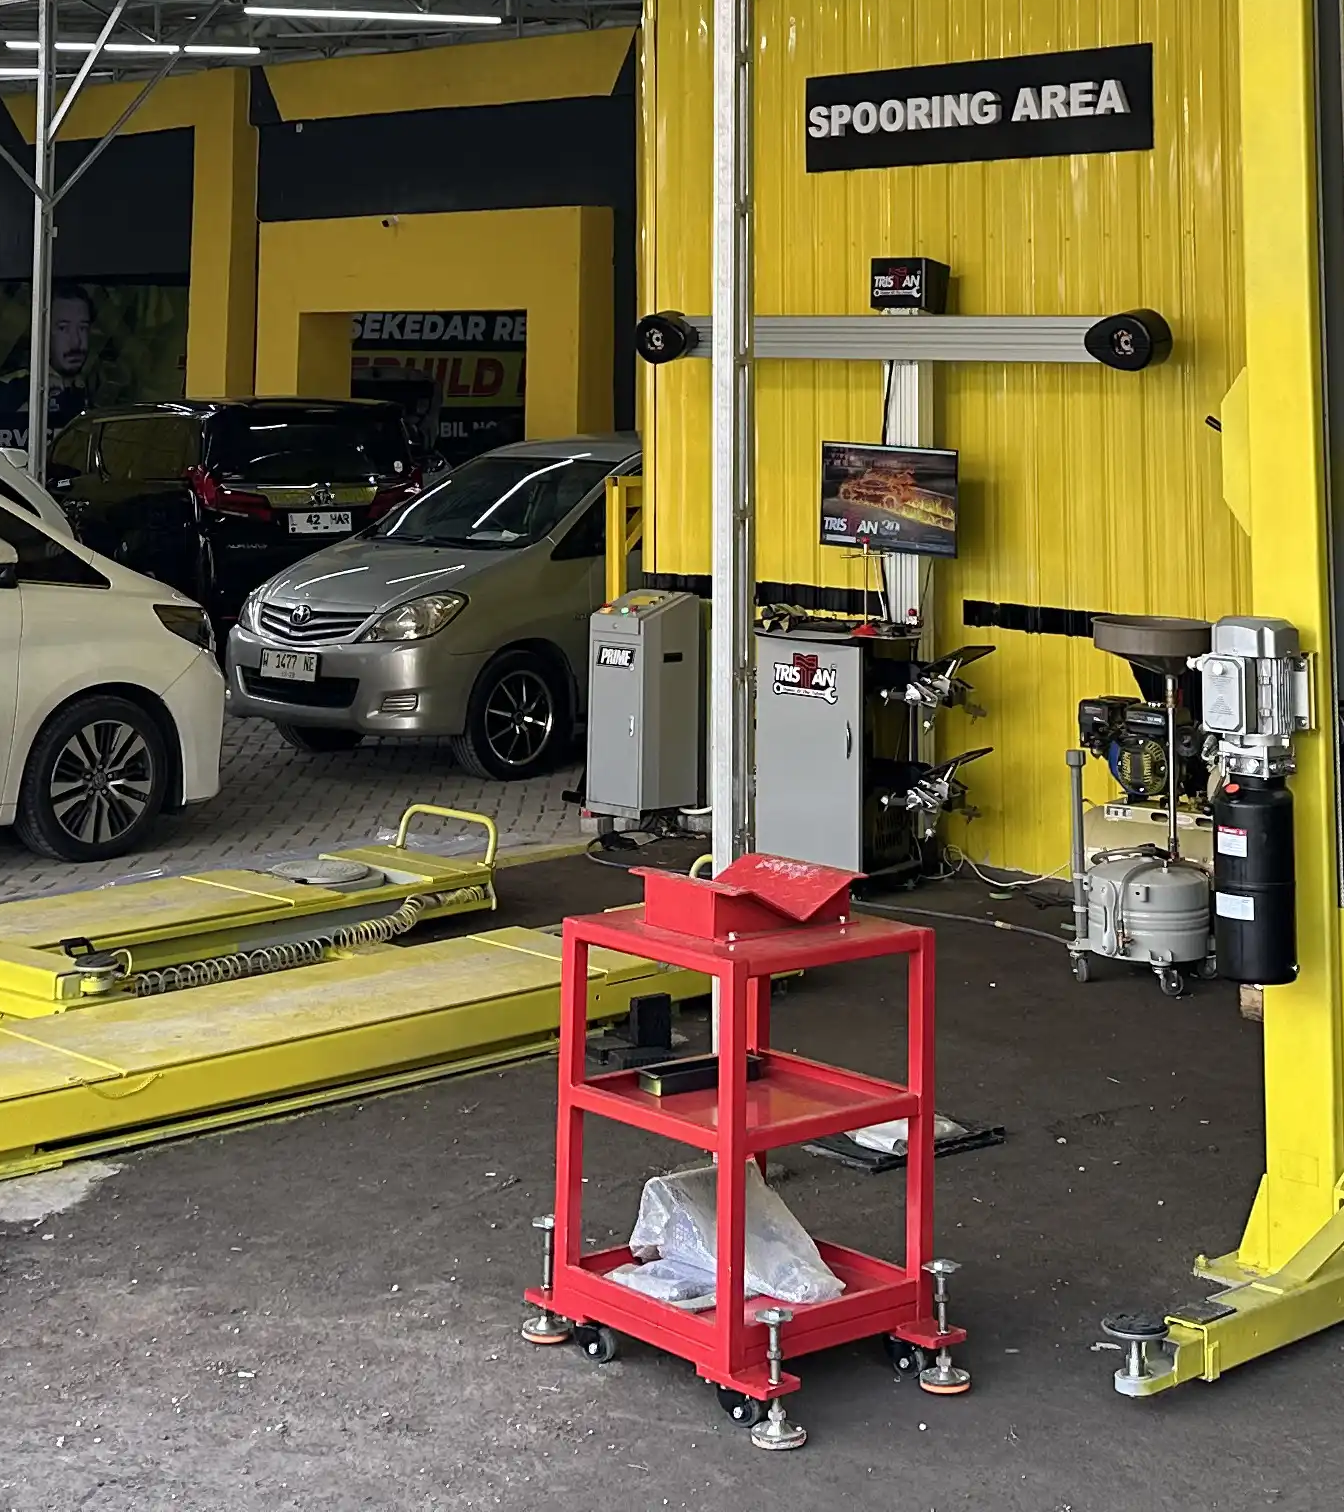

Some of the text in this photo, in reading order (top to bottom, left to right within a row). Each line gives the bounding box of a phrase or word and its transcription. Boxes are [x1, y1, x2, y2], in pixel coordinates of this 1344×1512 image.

[807, 79, 1131, 138] SPOORING AREA
[306, 514, 321, 525] 42
[275, 653, 298, 669] 1477
[303, 655, 315, 672] NE
[600, 647, 632, 667] PRIME
[774, 653, 836, 688] TRISTAN
